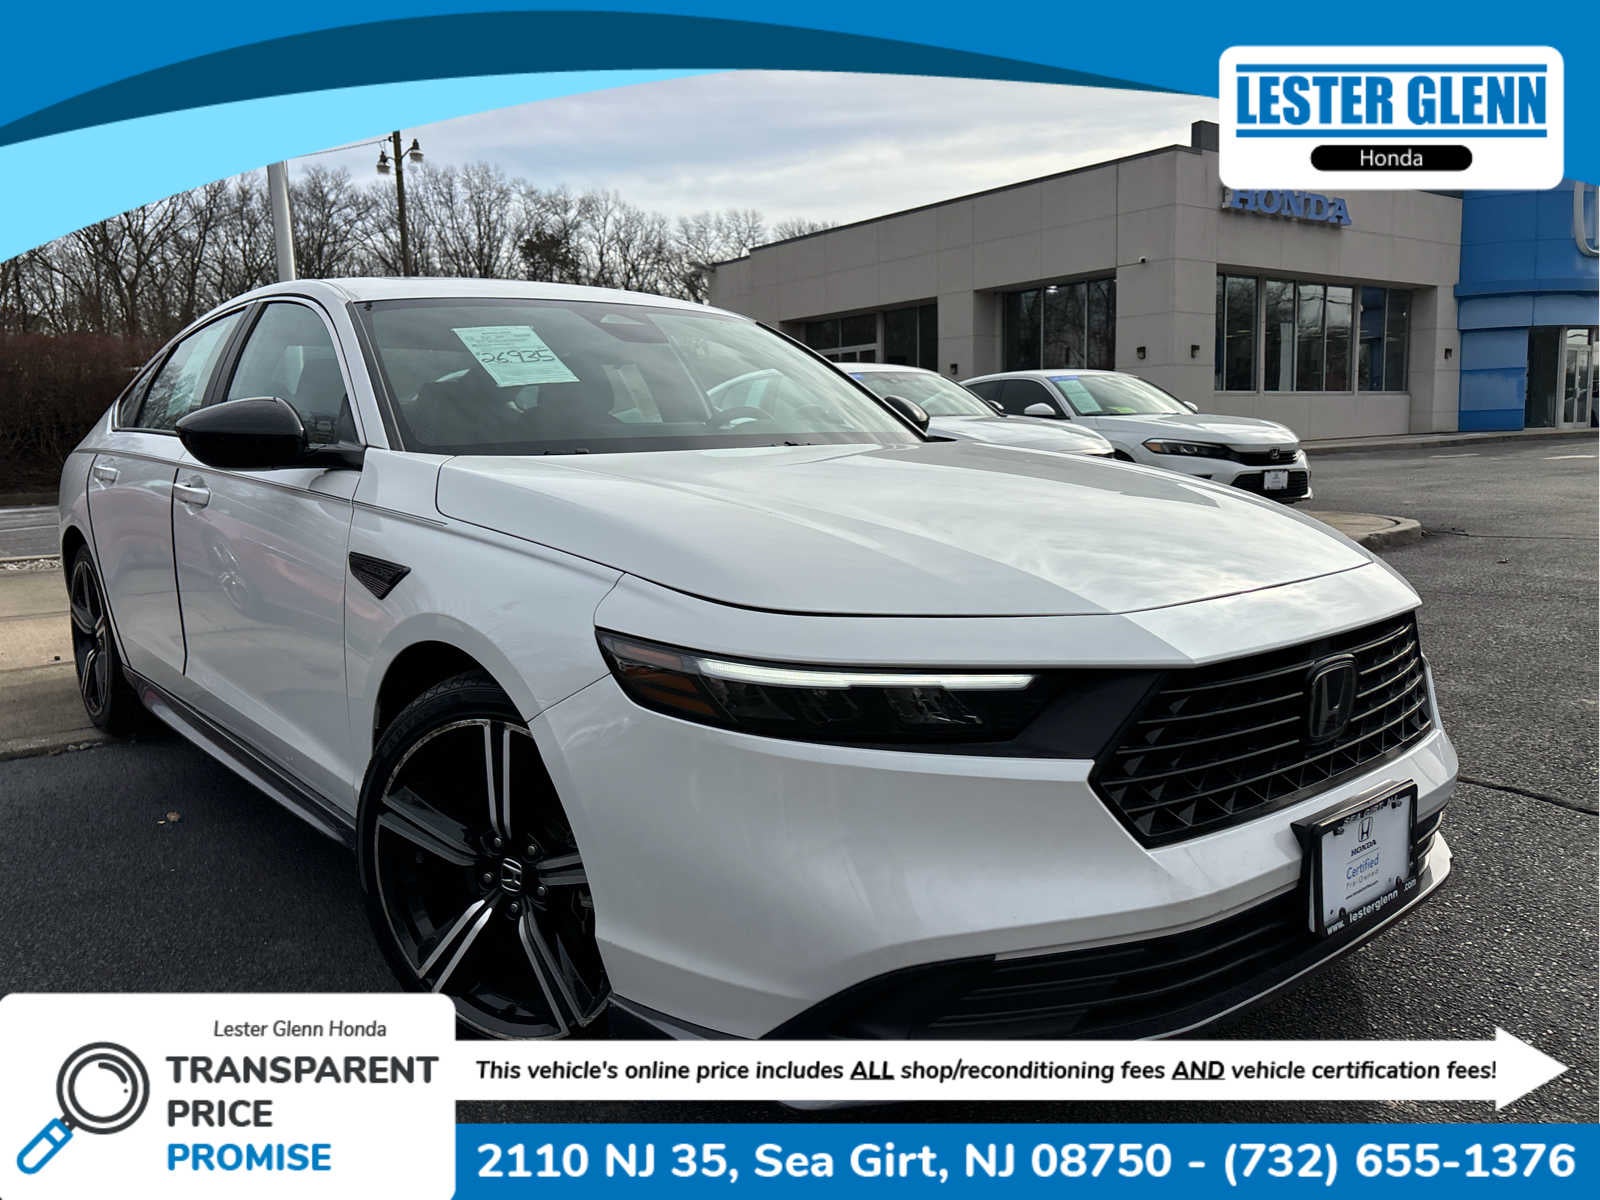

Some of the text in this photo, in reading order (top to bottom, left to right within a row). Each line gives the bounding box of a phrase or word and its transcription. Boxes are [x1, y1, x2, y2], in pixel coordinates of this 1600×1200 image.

[1229, 189, 1352, 225] HONDA
[1346, 855, 1379, 880] Certified
[1349, 890, 1398, 923] lesterglenn
